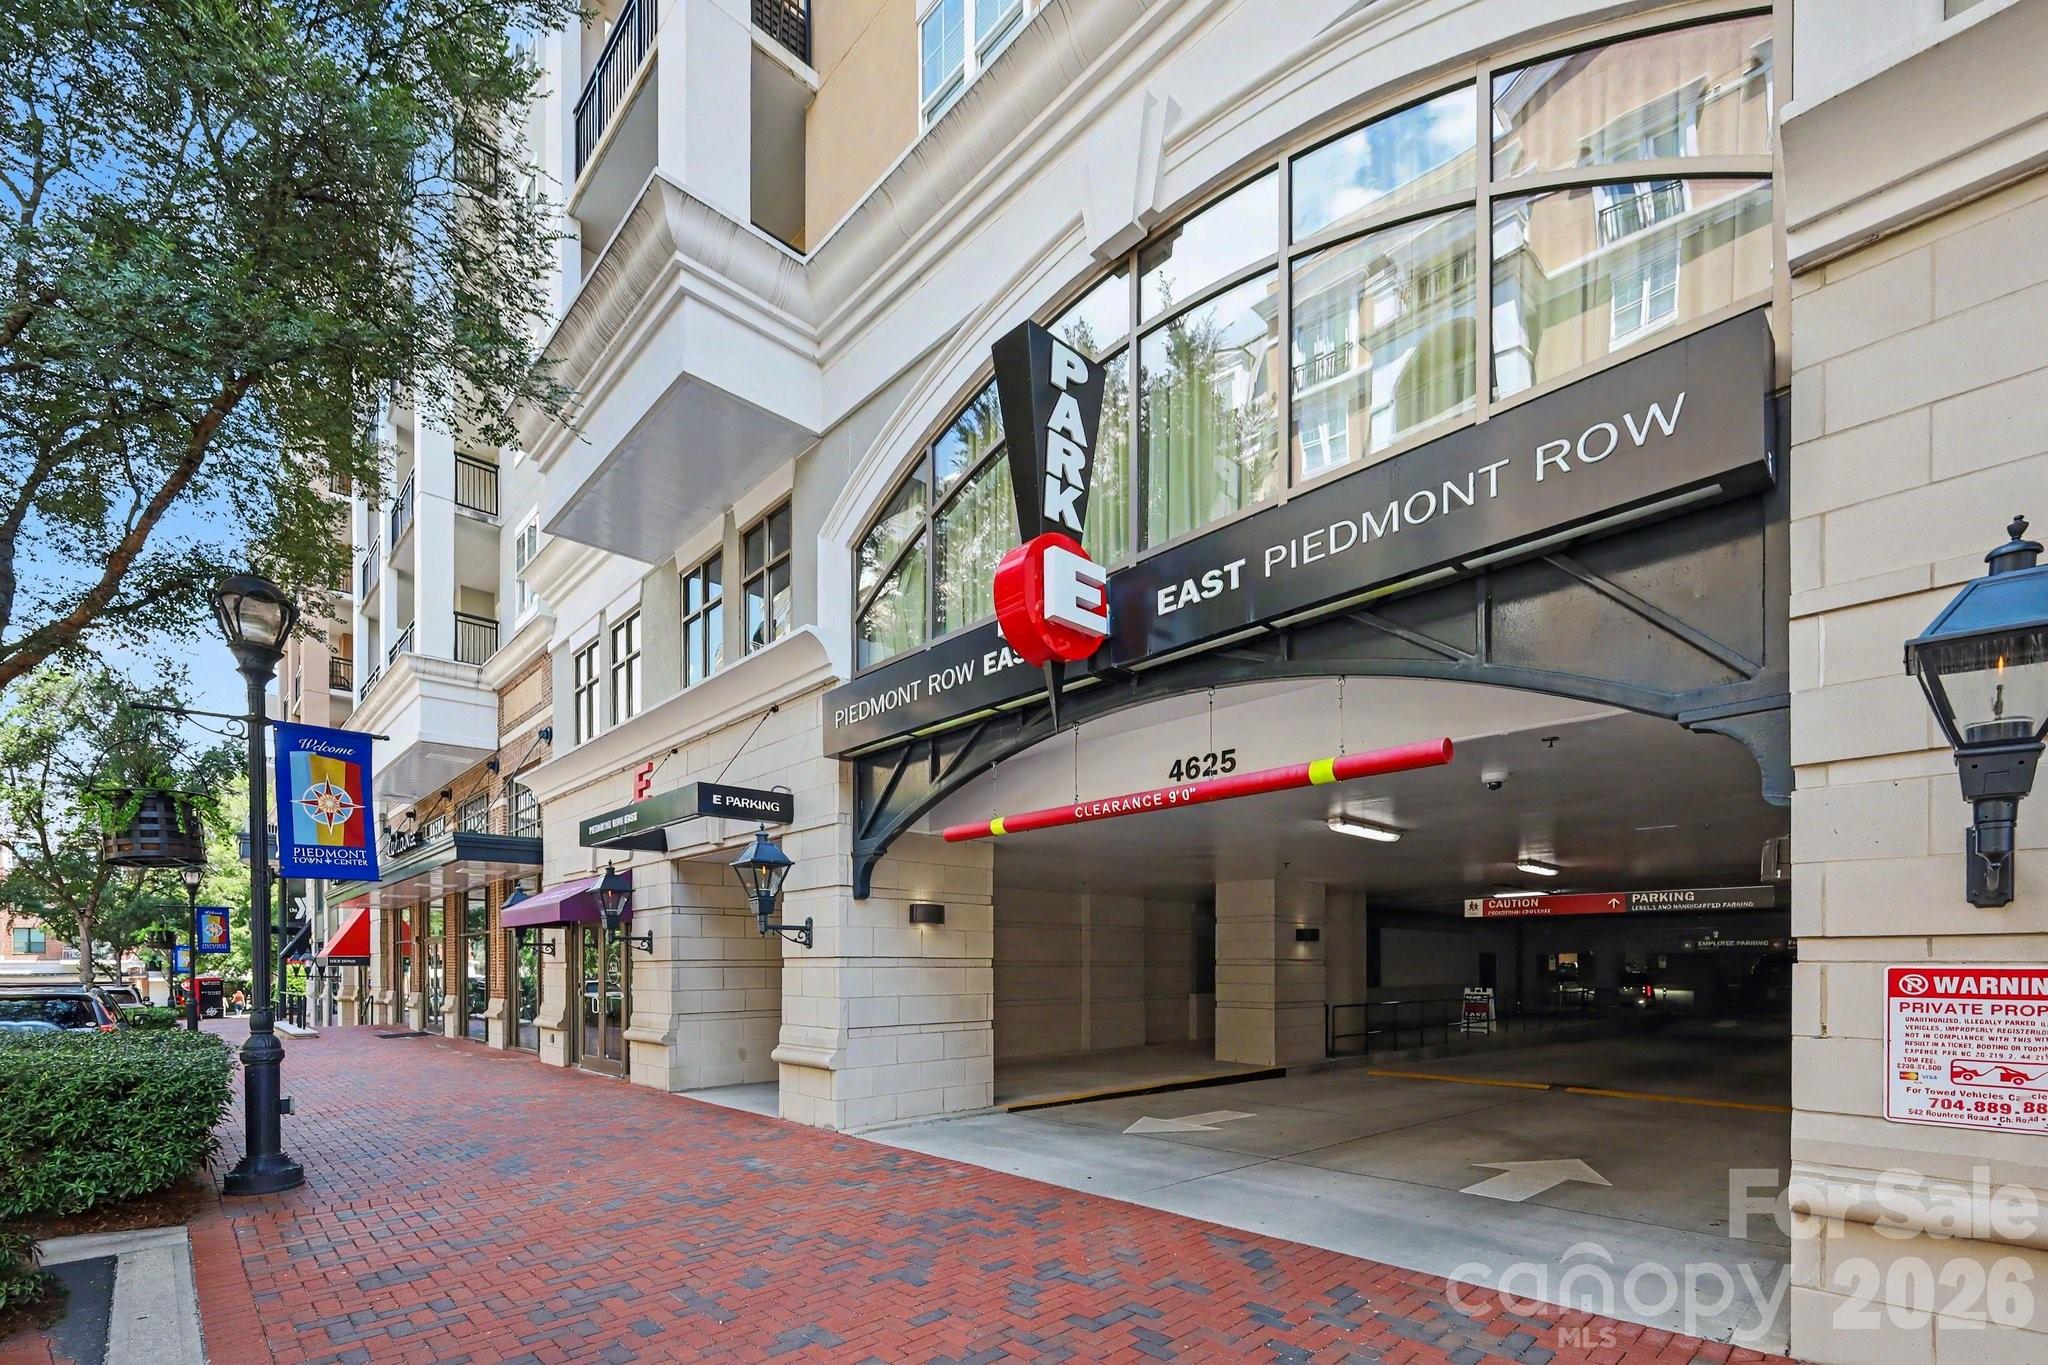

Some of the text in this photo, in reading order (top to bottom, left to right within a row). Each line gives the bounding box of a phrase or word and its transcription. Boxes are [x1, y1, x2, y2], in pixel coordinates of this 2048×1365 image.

[1043, 339, 1089, 534] PARK
[1157, 391, 1687, 617] EAST PIEDMONT ROW
[1043, 545, 1110, 636] E
[834, 679, 922, 729] PIEDMONT
[928, 659, 975, 696] ROW
[298, 738, 356, 756] Welcome
[1168, 748, 1237, 782] 4625
[633, 761, 653, 803] E
[712, 794, 780, 812] E PARKING
[1075, 792, 1162, 818] CLEARANCE
[292, 856, 368, 866] TOWN CENTER
[293, 847, 367, 859] PIEDMONT
[1488, 898, 1539, 909] CAUTION
[1632, 892, 1695, 903] PARKING
[1673, 902, 1721, 910] HANDICAPPED
[1899, 1002, 1983, 1015] PRIVATE
[1933, 1033, 1984, 1041] COMPLIANCE
[1906, 1086, 1921, 1094] For
[1925, 1087, 1956, 1096] Towed
[1960, 1089, 2004, 1100] Vehicles
